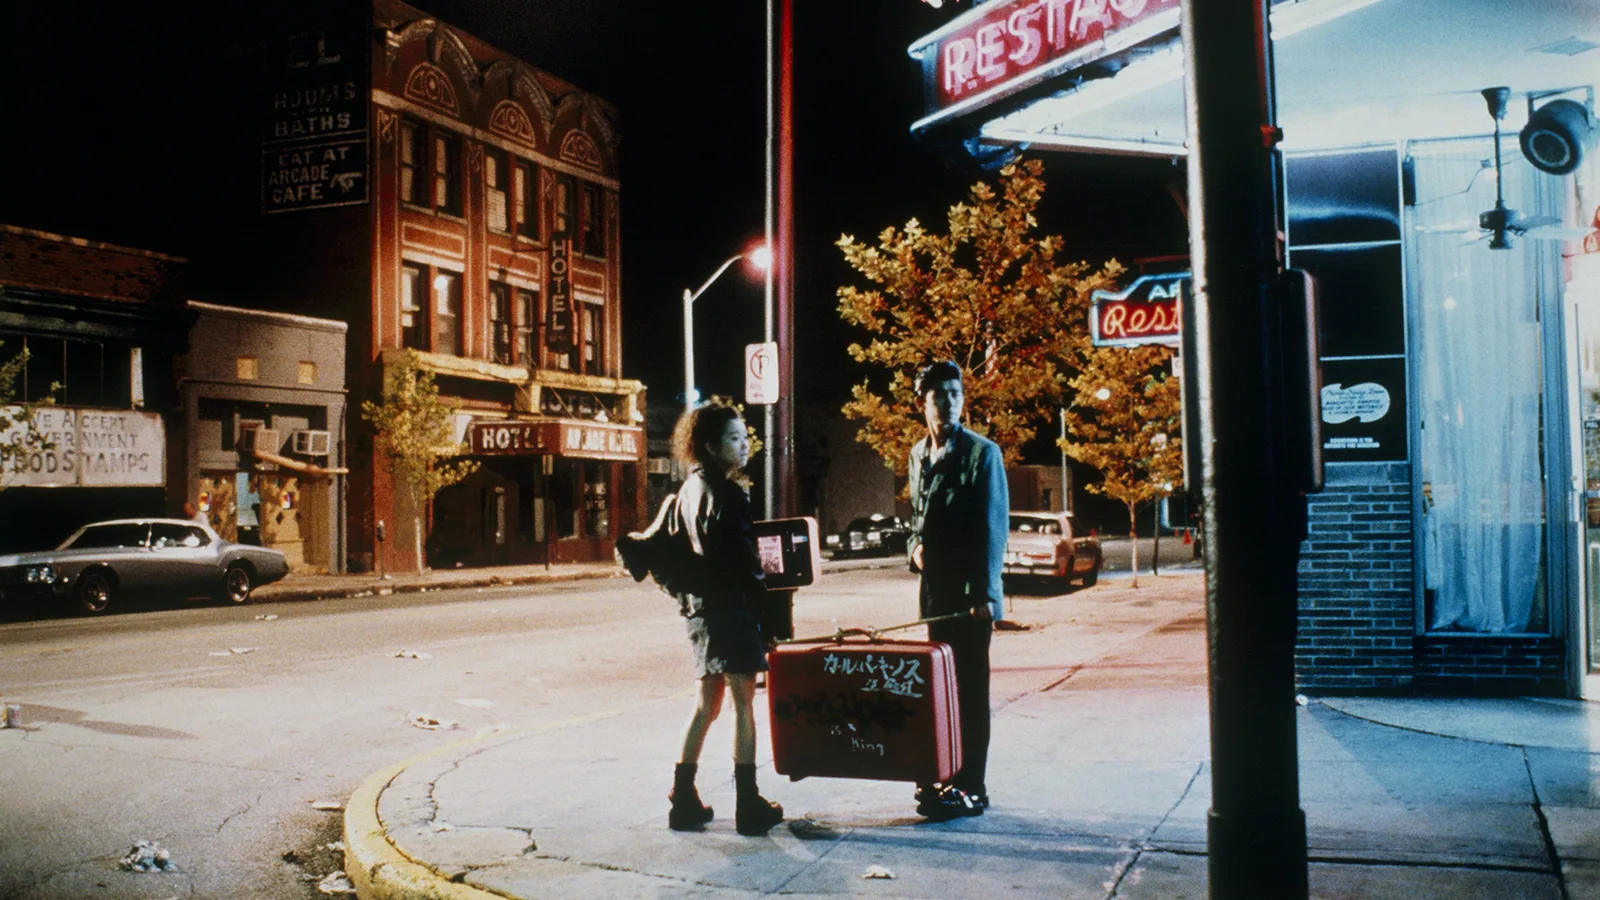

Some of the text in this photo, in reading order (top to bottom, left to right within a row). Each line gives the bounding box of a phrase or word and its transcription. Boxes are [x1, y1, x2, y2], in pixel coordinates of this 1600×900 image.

[274, 112, 351, 137] BATHS
[278, 146, 349, 166] EAT AT
[268, 163, 330, 185] ARCADE
[271, 182, 324, 204] CAFE
[551, 239, 567, 331] HOTEL
[62, 411, 128, 430] ACCEPT
[62, 450, 149, 474] STAMPS
